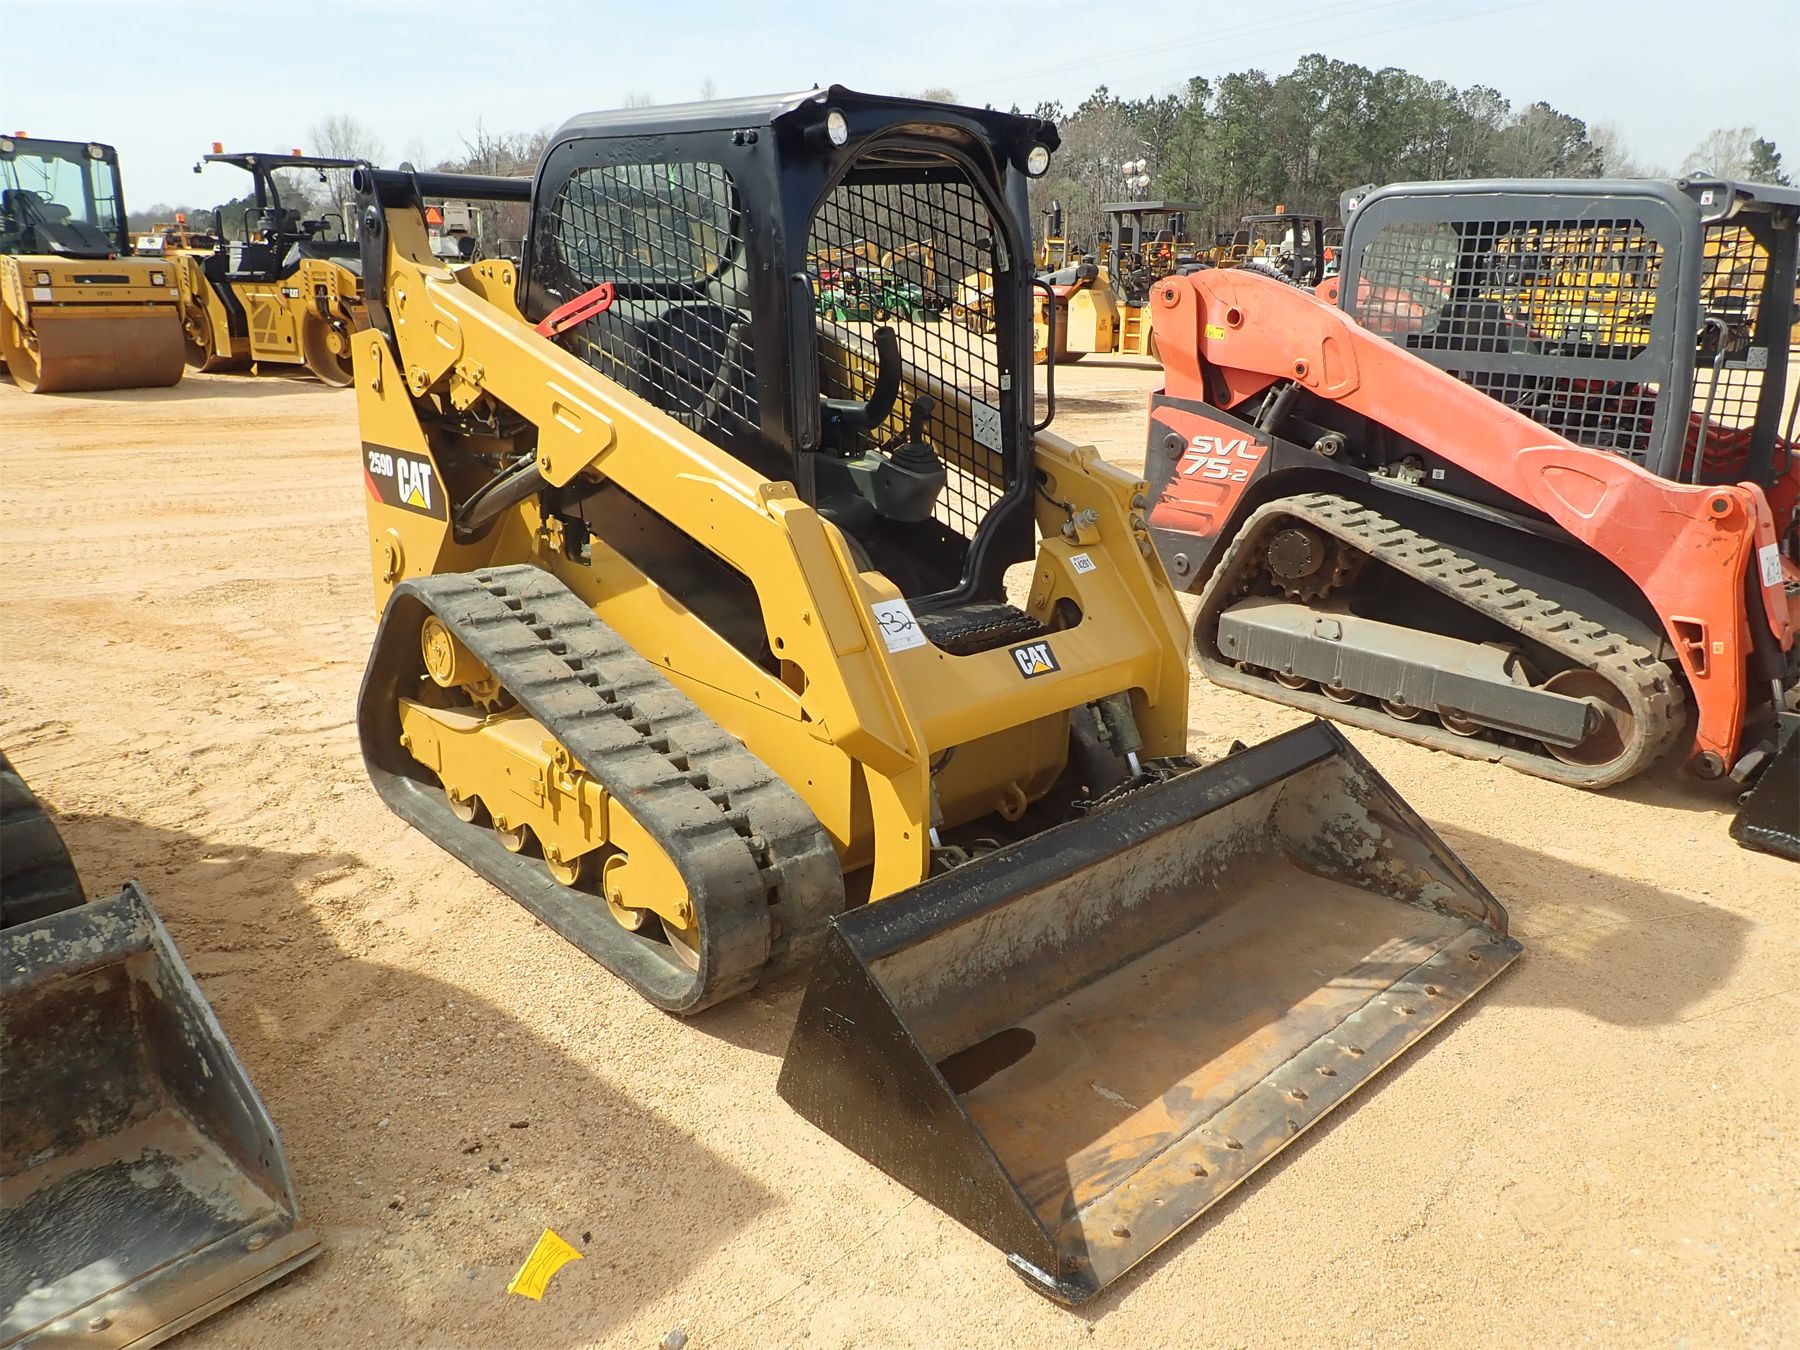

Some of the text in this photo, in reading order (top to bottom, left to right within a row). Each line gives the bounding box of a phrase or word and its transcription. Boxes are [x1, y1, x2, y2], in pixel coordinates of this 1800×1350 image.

[1188, 435, 1258, 460] SVL
[368, 450, 432, 510] 259D CAT
[1183, 454, 1248, 482] 75-2
[1014, 643, 1055, 675] CAT
